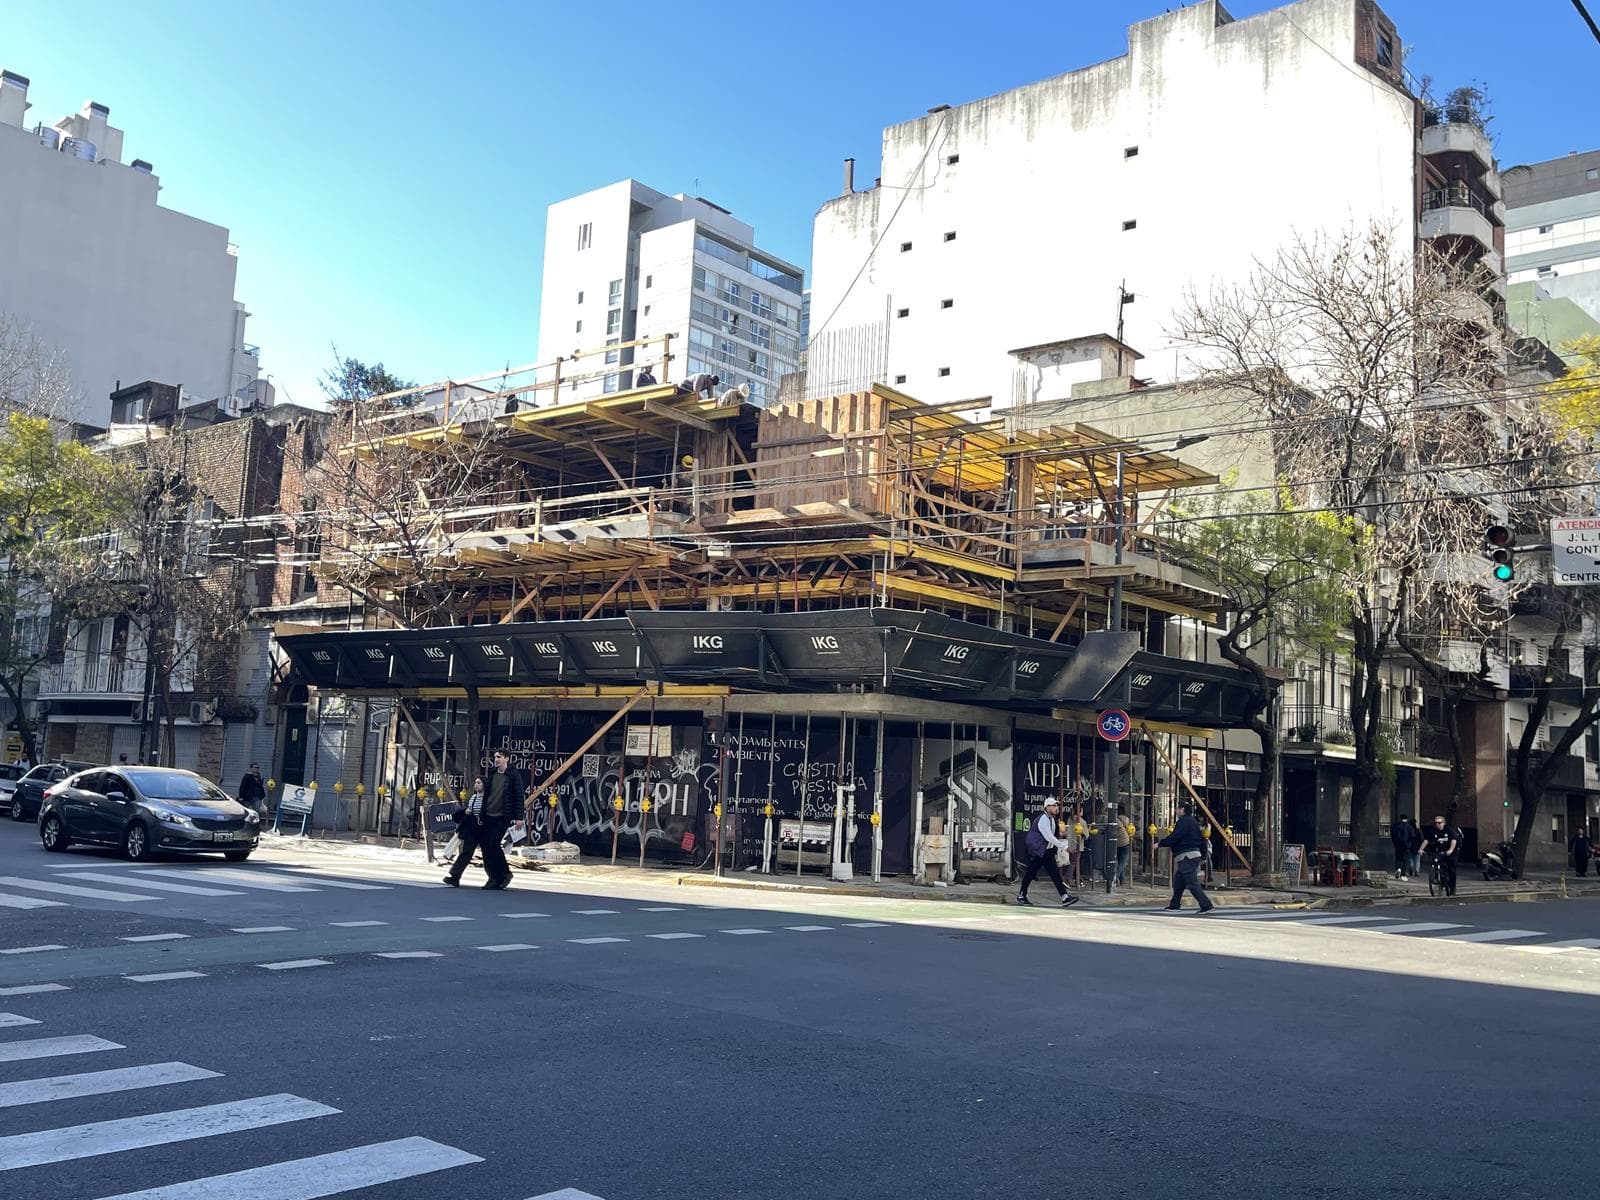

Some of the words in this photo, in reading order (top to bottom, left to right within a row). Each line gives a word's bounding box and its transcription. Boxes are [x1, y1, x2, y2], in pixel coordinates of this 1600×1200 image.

[1557, 520, 1600, 529] ATENCI
[535, 642, 559, 654] IKG
[592, 640, 617, 653] IKG
[693, 635, 723, 649] IKG
[811, 635, 839, 649] IKG
[311, 650, 331, 661] IKG
[365, 648, 385, 659] IKG
[423, 647, 446, 658] IKG
[481, 644, 505, 656] IKG
[944, 644, 969, 659] IKG
[1018, 660, 1040, 674] IKG
[1132, 673, 1152, 686] IKG
[1185, 681, 1204, 693] IKG
[502, 735, 546, 757] Borges
[712, 748, 719, 759] 2
[1024, 762, 1070, 789] ALEPH
